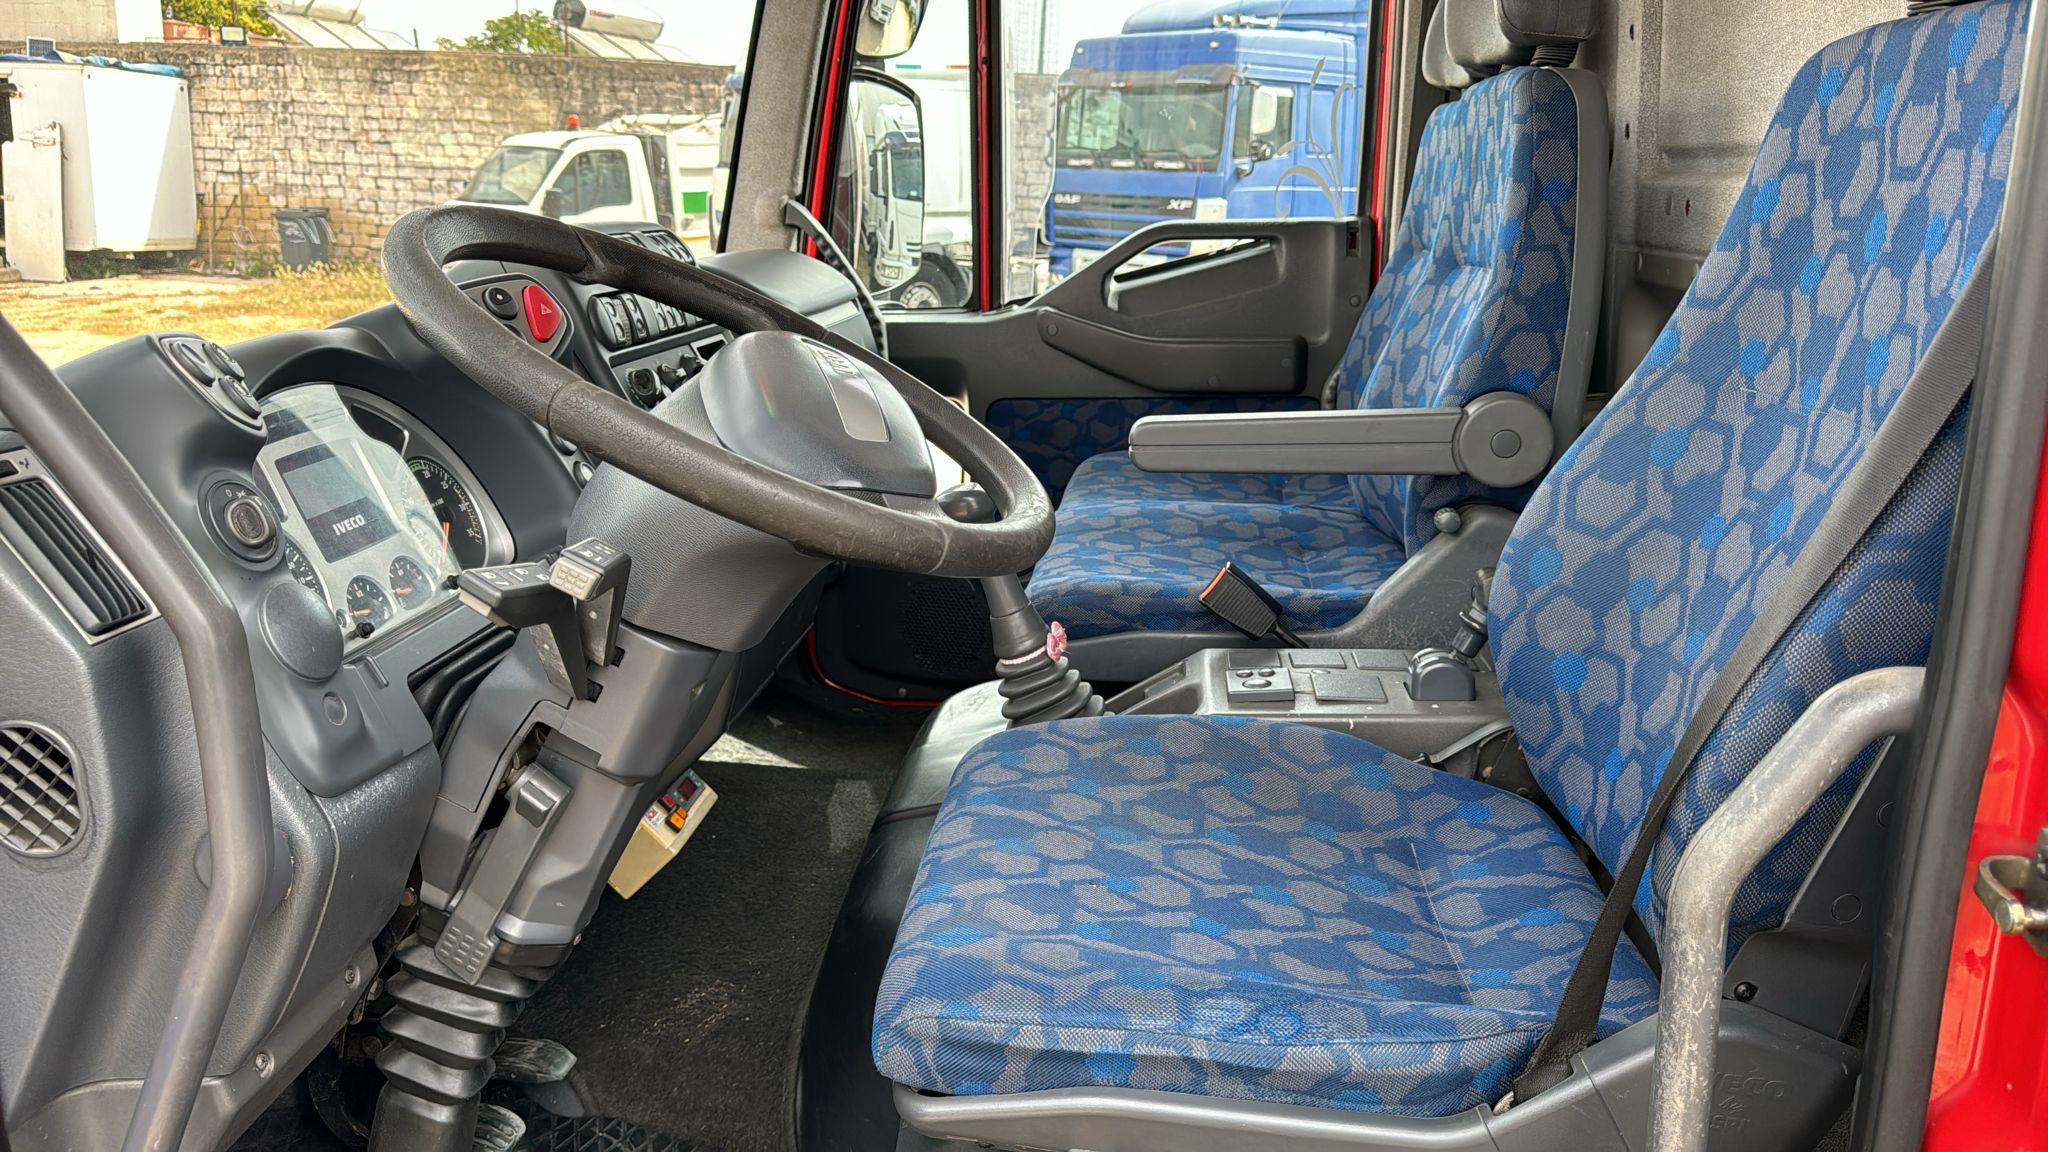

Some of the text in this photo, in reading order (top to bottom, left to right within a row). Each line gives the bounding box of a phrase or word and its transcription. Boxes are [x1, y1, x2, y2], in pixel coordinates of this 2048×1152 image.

[1054, 193, 1081, 205] DAF
[1166, 199, 1193, 210] XF
[332, 514, 366, 536] IVECO
